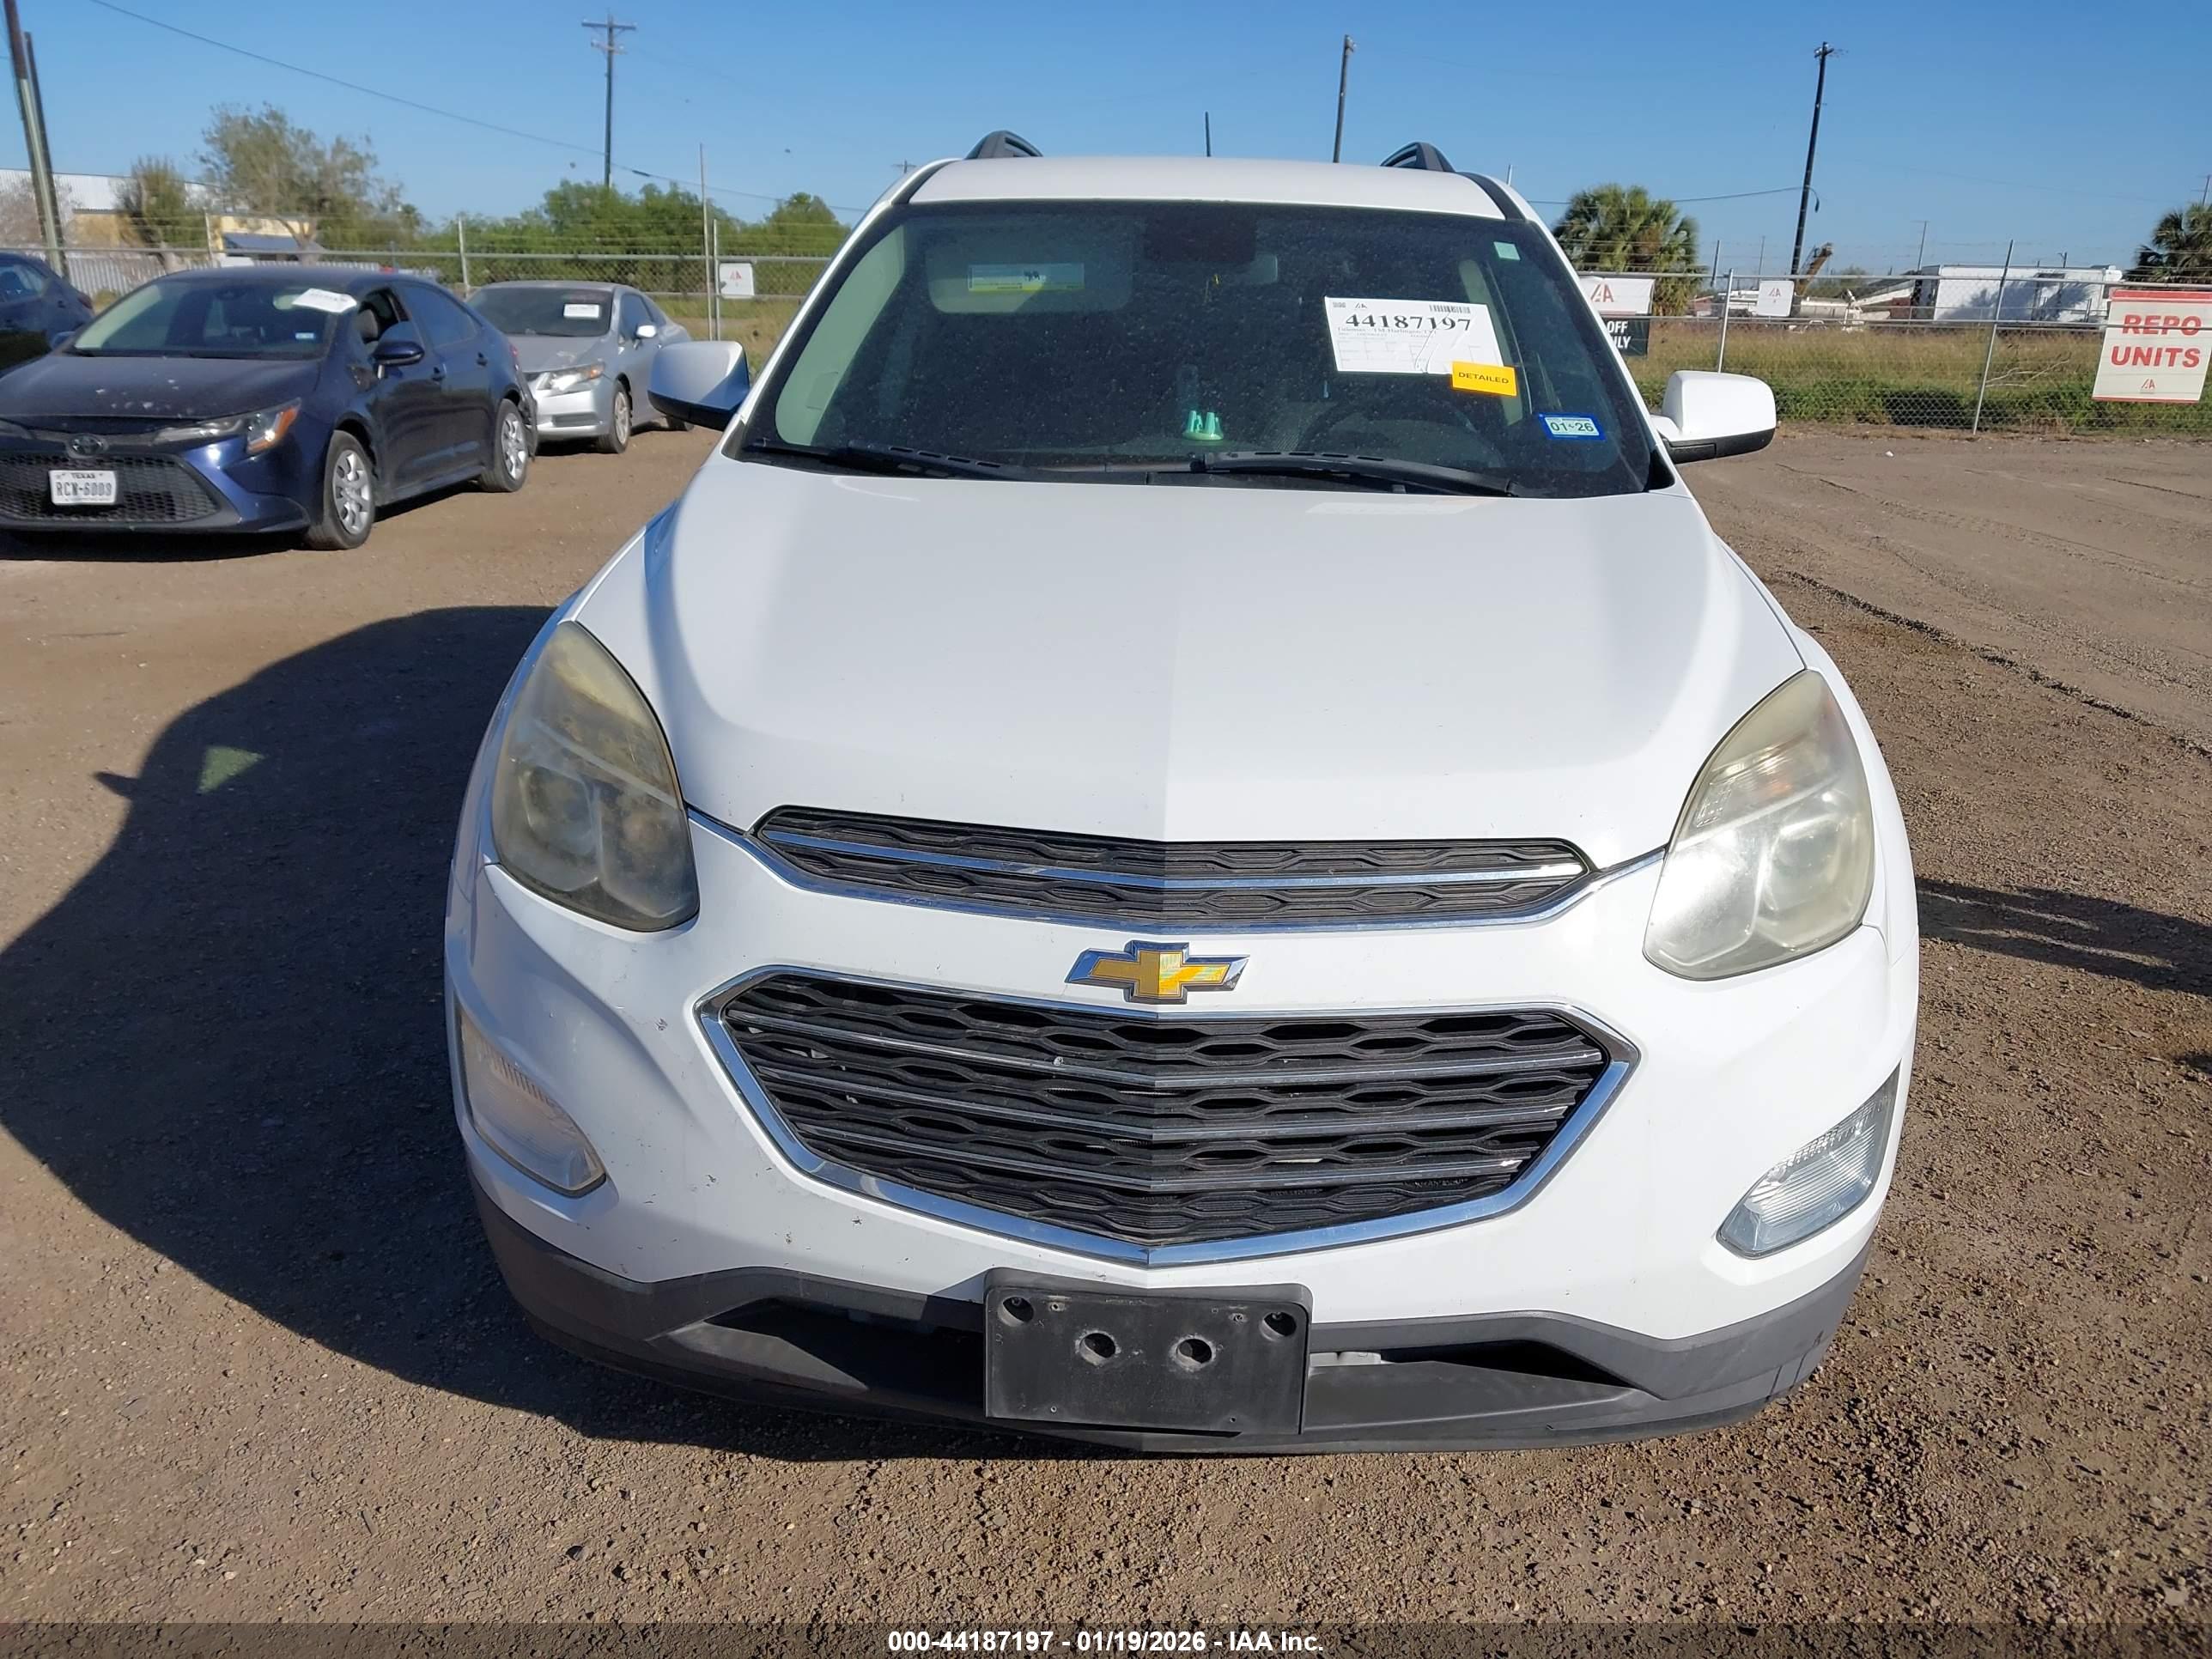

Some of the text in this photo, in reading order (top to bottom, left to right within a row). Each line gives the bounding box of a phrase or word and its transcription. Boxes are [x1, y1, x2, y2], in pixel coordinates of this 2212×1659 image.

[1346, 314, 1471, 331] 44187197
[1607, 320, 1629, 333] OFF
[2122, 314, 2202, 336] REPO
[2111, 346, 2201, 368] UNITS
[1458, 372, 1510, 384] DETAILED
